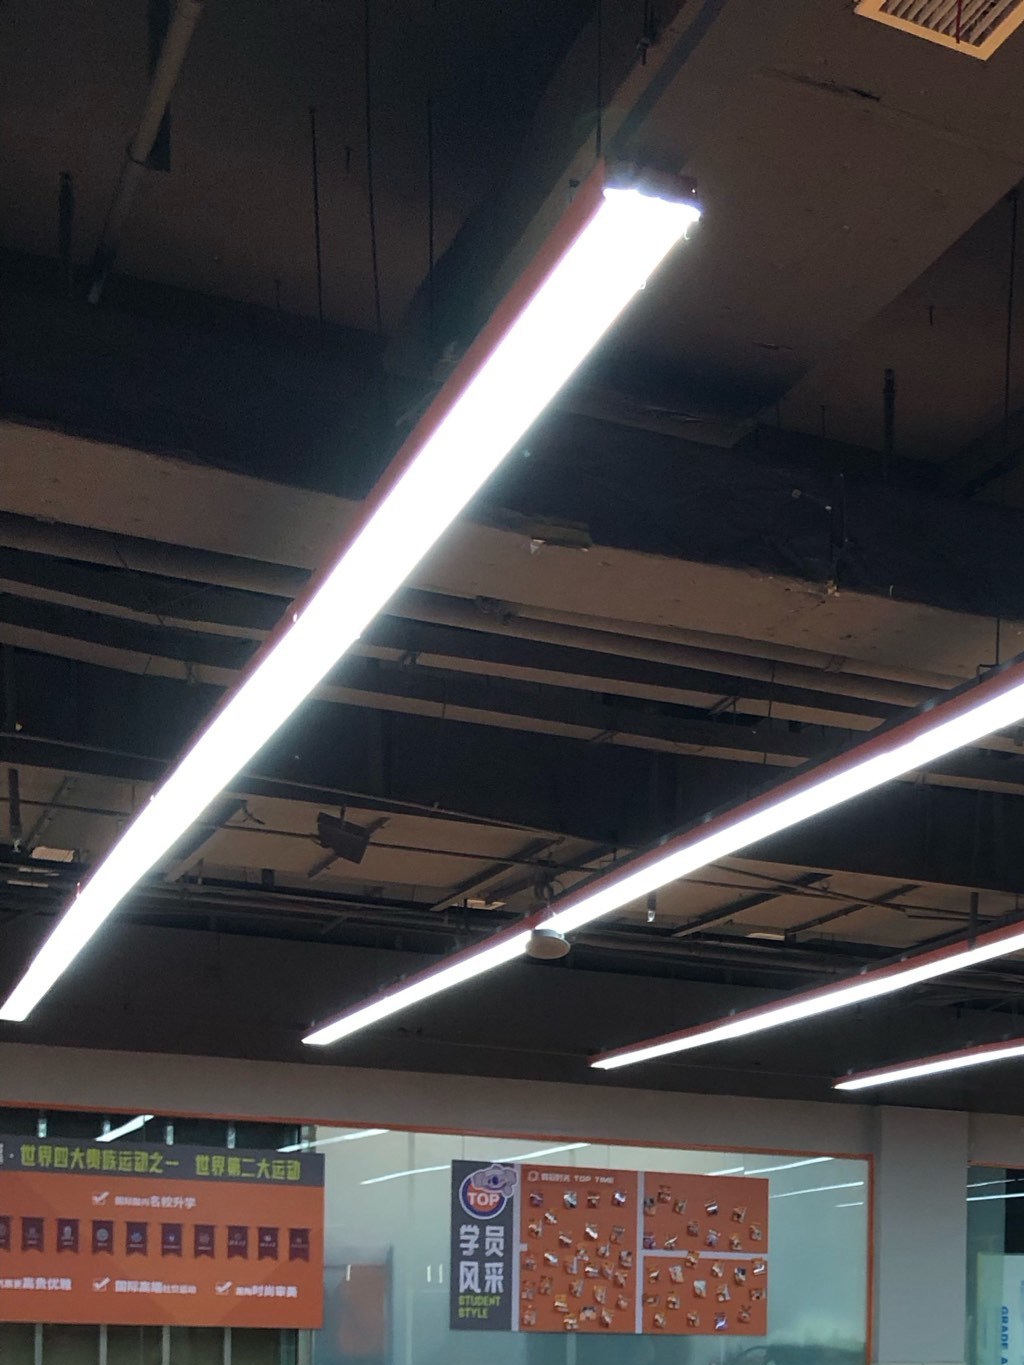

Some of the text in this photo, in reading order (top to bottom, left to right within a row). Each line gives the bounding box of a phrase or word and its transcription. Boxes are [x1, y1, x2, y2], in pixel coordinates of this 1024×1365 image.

[20, 1144, 179, 1174] 世界四大贵族运动之一
[195, 1154, 302, 1181] 世界第二大运动
[466, 1191, 500, 1208] TOP
[459, 1224, 505, 1258] 学员
[459, 1261, 505, 1294] 风采
[458, 1295, 502, 1308] STUDENT
[458, 1307, 489, 1320] STYLE
[1000, 1306, 1009, 1350] GRADE
